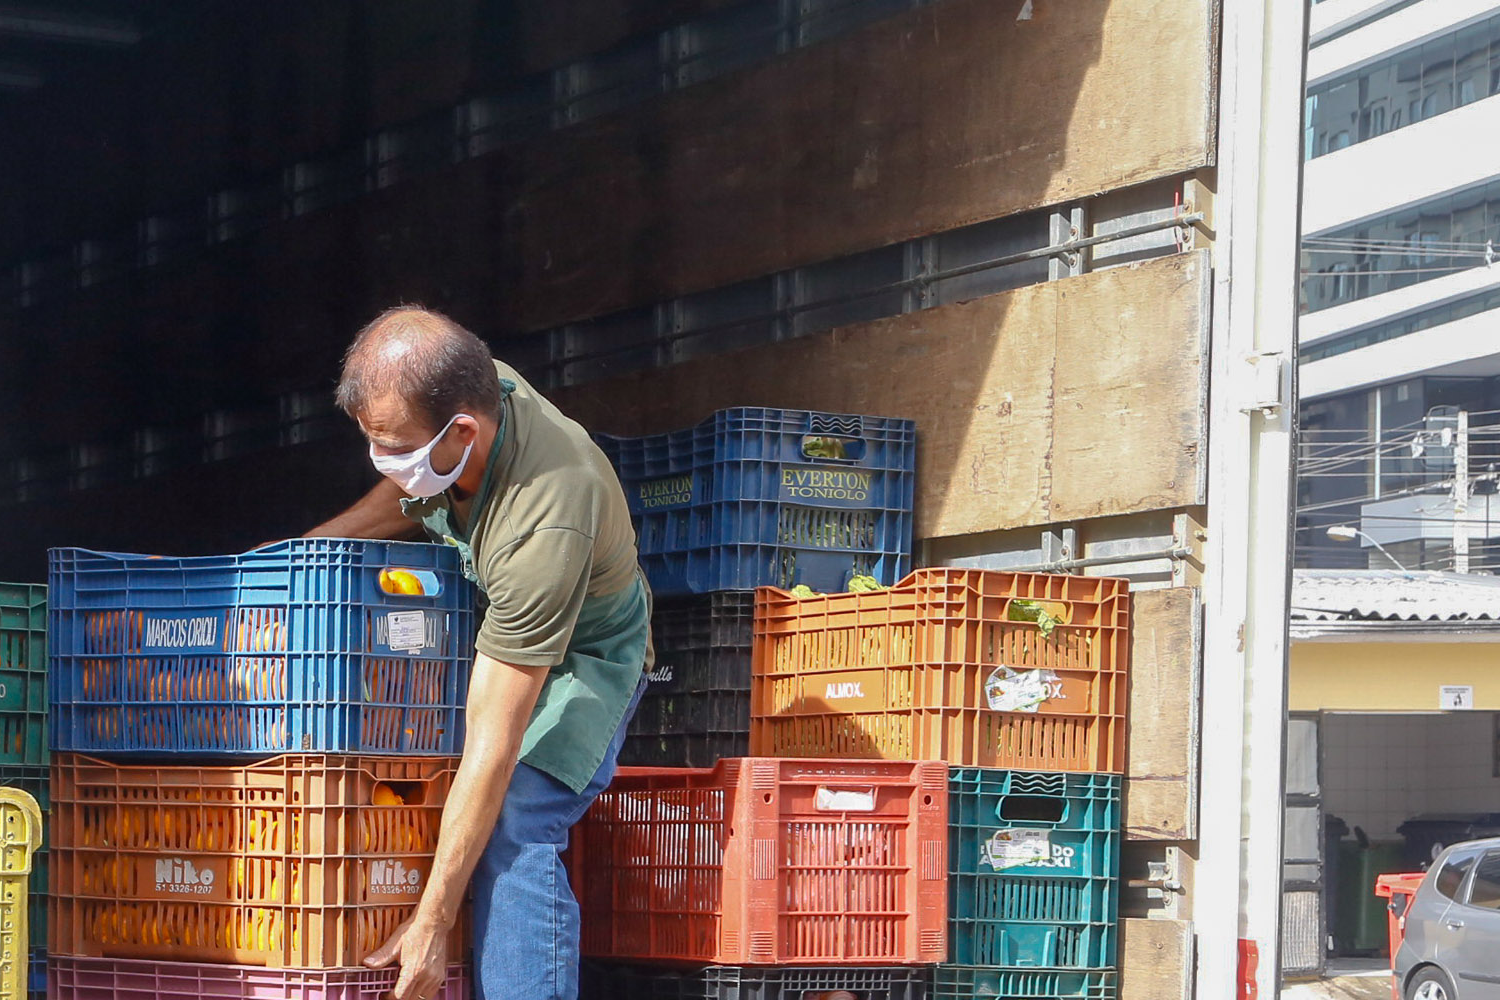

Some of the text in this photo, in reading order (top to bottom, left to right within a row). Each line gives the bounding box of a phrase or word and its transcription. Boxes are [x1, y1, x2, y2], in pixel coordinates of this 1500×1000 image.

[640, 475, 693, 498] EVERTON
[781, 469, 872, 490] EVERTON
[643, 493, 692, 508] TONIOLO
[787, 486, 867, 501] TONIOLO
[145, 617, 187, 648] MARCOS
[825, 682, 864, 699] ALMOX.
[155, 857, 214, 885] Niko
[371, 858, 420, 885] Niko
[169, 884, 213, 894] 3326-1207
[381, 885, 420, 894] 3326-1207
